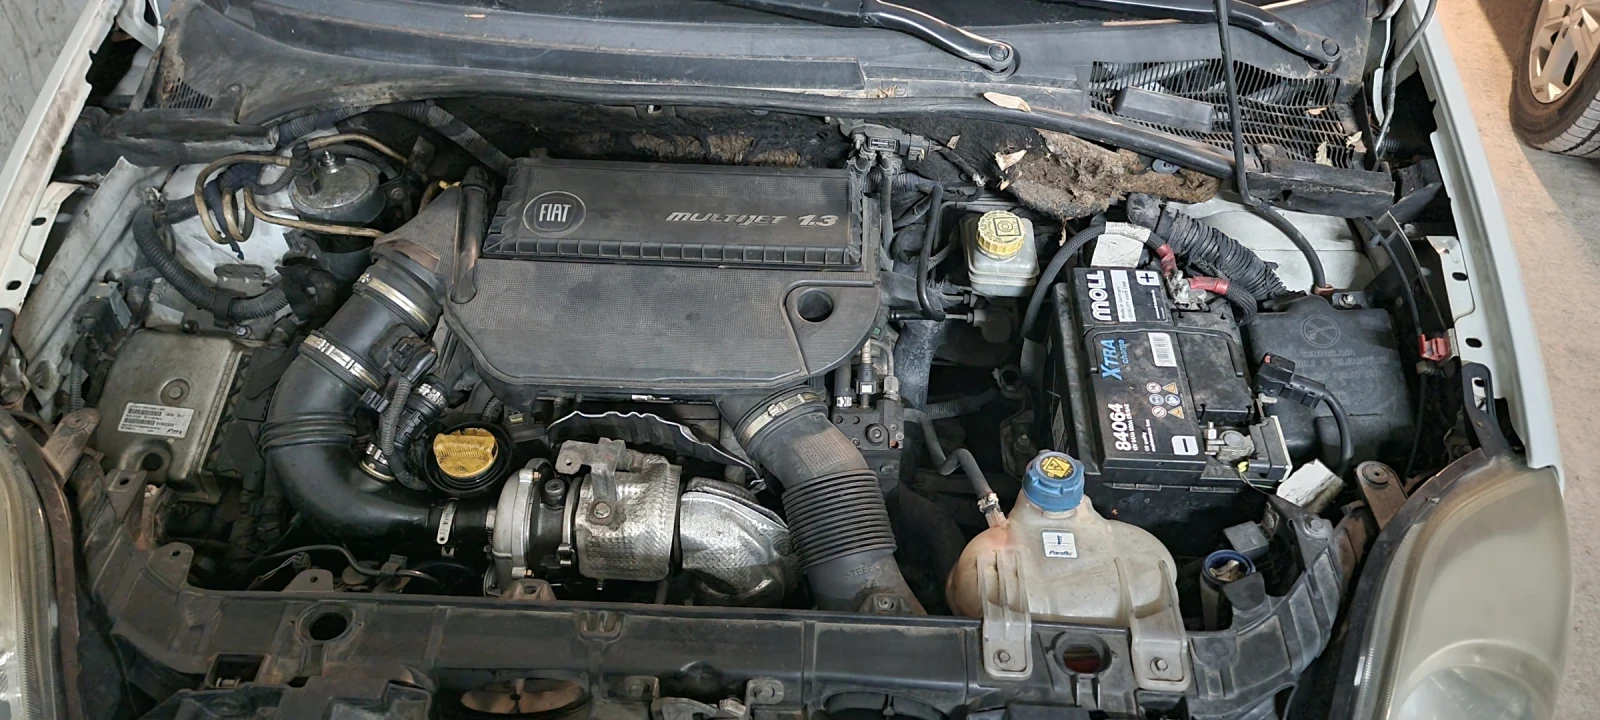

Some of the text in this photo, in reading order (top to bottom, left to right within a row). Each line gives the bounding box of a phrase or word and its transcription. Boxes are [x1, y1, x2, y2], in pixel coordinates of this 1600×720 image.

[538, 203, 572, 223] FIAT
[665, 211, 839, 228] MULTIJET 1.3
[1086, 270, 1112, 320] MOLL
[1100, 339, 1123, 381] XTRA
[1118, 339, 1129, 364] charge
[1107, 402, 1132, 451] 84064
[1141, 431, 1149, 446] quality
